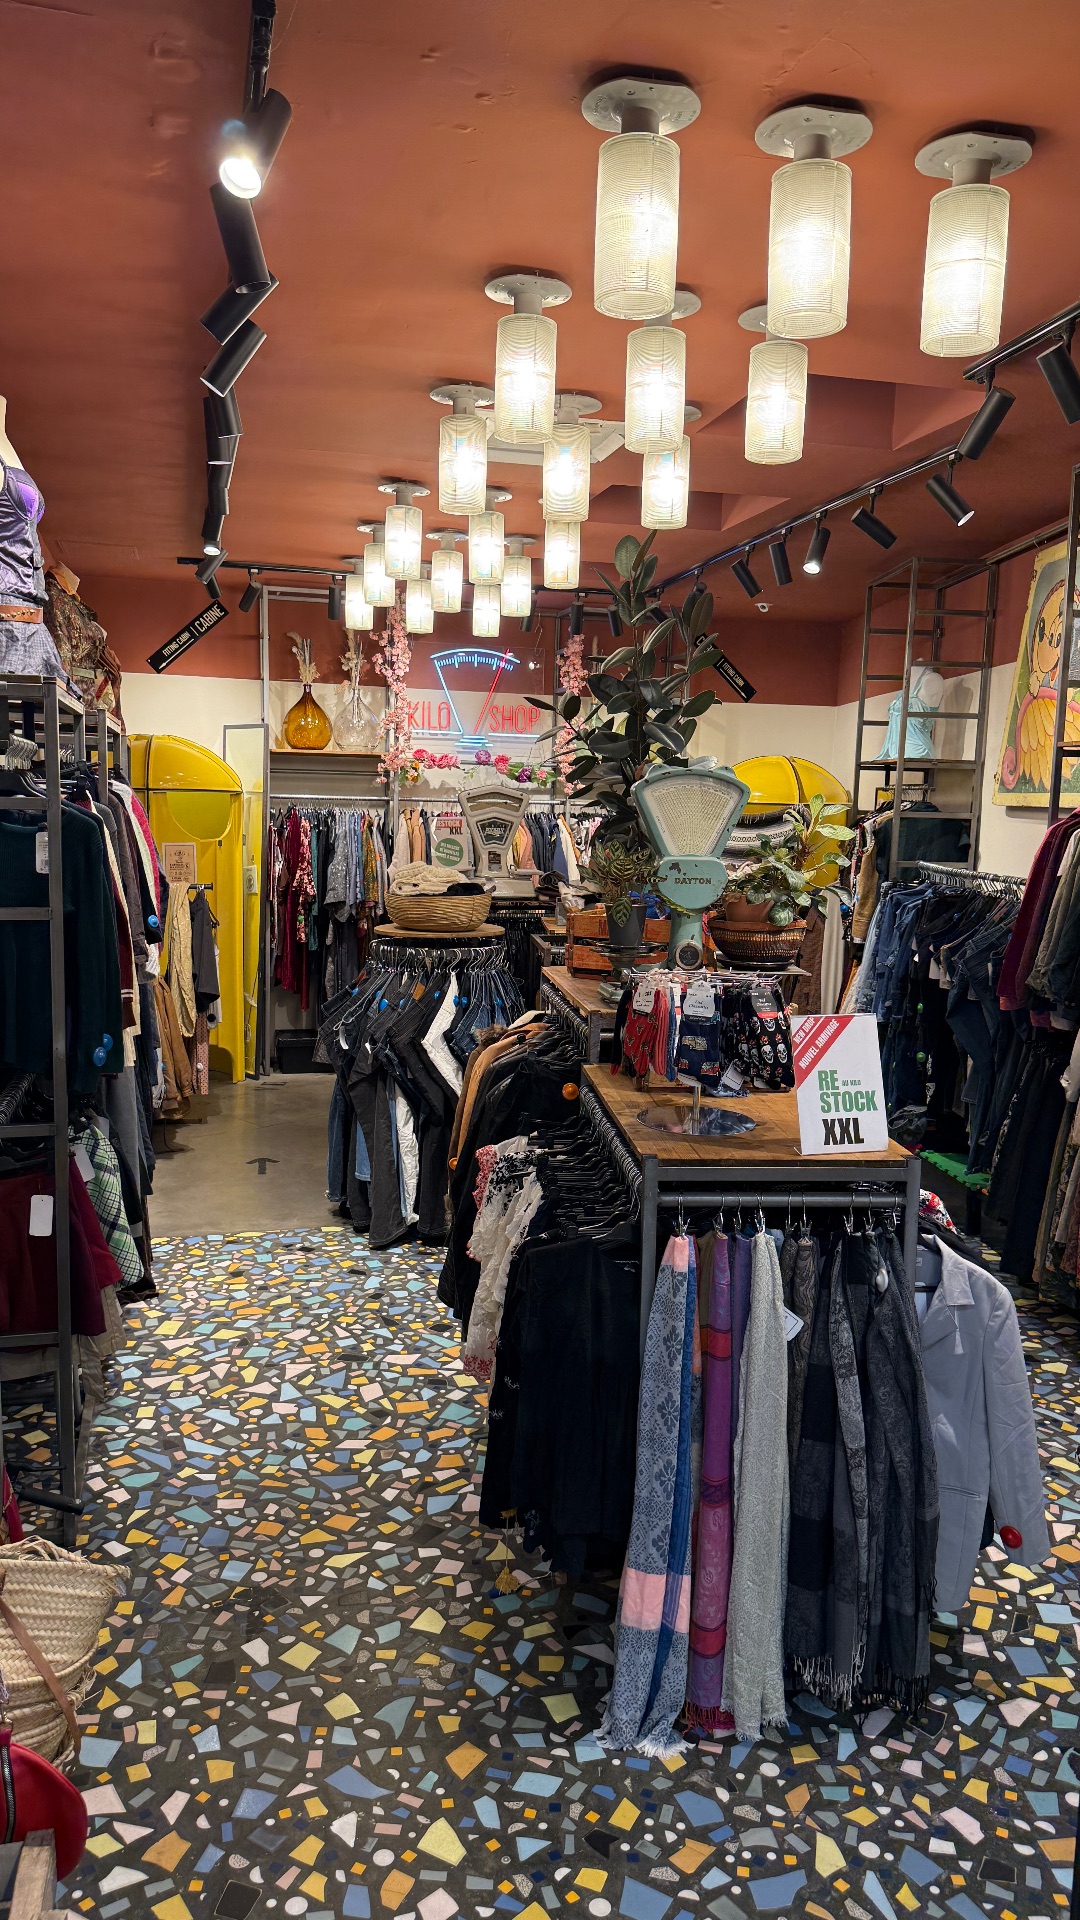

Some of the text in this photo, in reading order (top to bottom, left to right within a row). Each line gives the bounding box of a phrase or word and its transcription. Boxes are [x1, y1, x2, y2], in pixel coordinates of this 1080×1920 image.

[194, 604, 225, 633] CABINE
[162, 631, 192, 657] FITTING CABIN
[722, 662, 736, 677] FITTING
[407, 701, 540, 734] KILO SHOP
[449, 827, 463, 835] XXL
[674, 877, 712, 885] DAYTON
[793, 1017, 816, 1045] NEW DROP
[798, 1018, 840, 1070] NOUVEL ARRIVAGE
[817, 1069, 840, 1092] RE
[819, 1090, 878, 1114] STOCK
[822, 1117, 865, 1146] XXL
